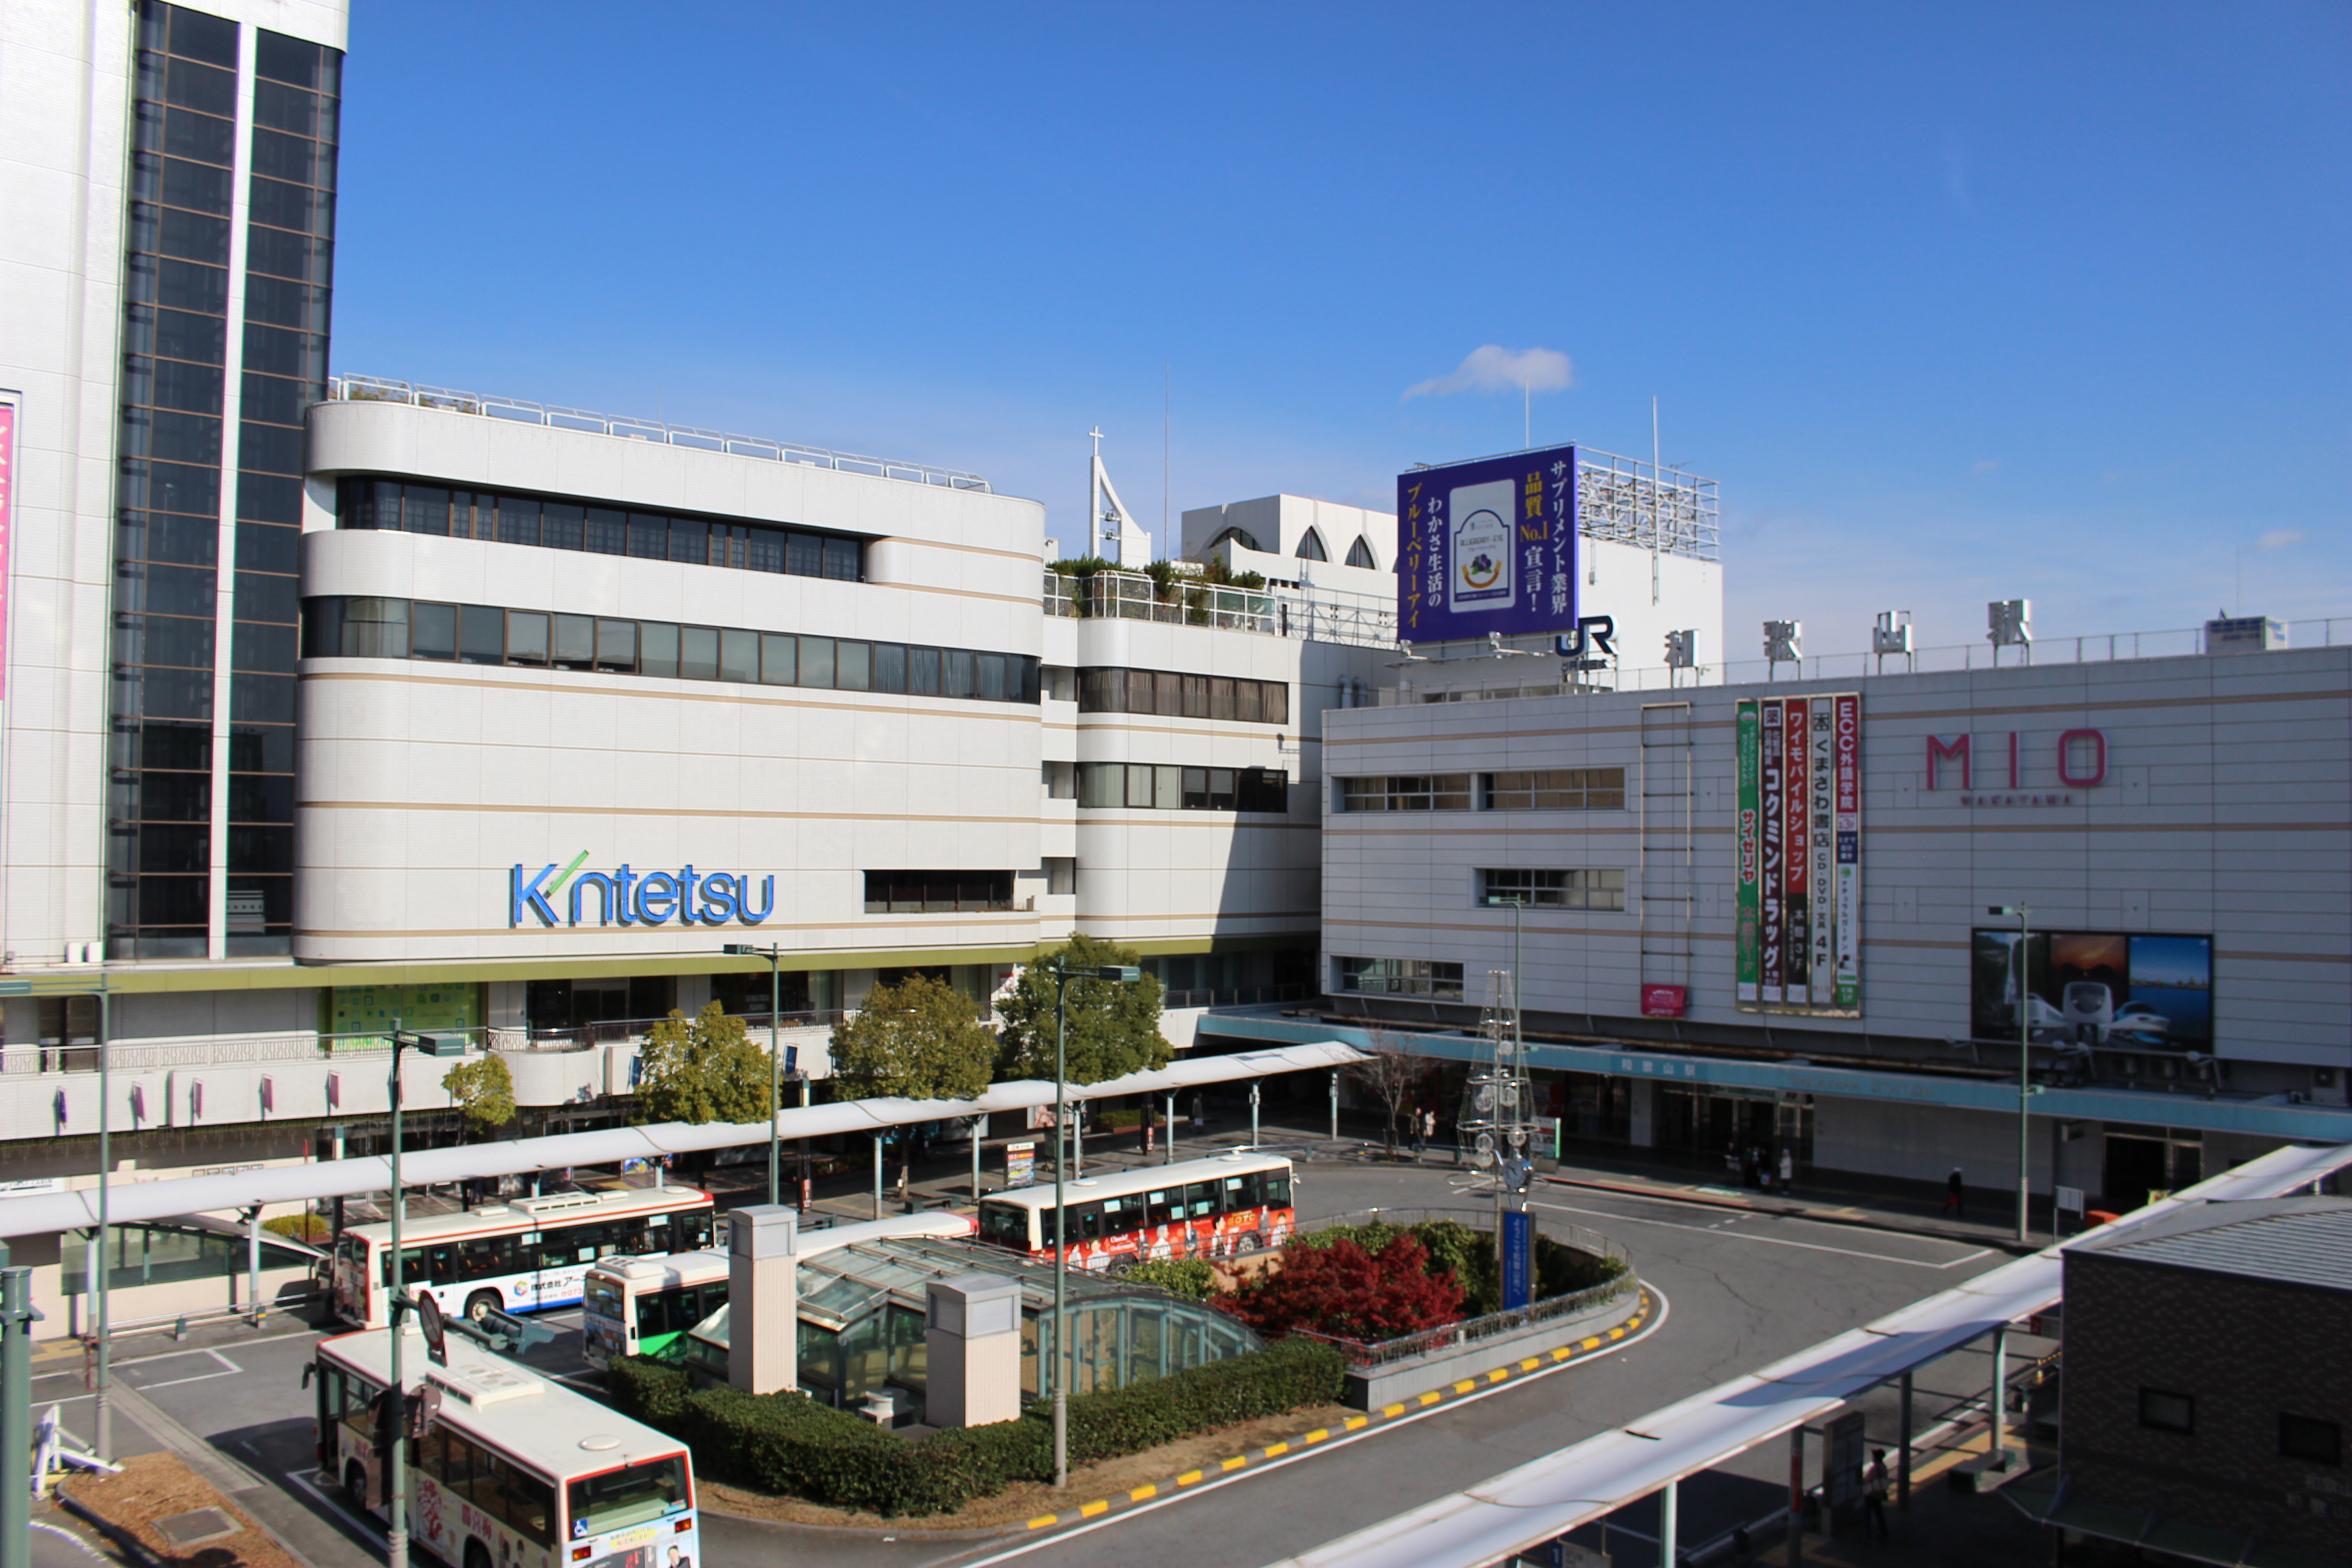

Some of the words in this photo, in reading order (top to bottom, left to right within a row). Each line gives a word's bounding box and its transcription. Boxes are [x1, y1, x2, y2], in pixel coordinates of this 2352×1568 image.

[1406, 482, 1423, 629] ブルーベリーアイ
[1426, 497, 1443, 607] わかさ生活の
[1551, 460, 1568, 616] サプリメント業界
[1555, 615, 1614, 657] JR
[1926, 728, 2106, 789] MIO
[1789, 712, 1805, 882] ワイモバイルショップ
[1959, 794, 2072, 806] WAKAYAMA
[1741, 809, 1757, 885] サイゼリヤ
[1764, 768, 1781, 969] コクミンドラッグ
[514, 849, 774, 923] Kintetsu
[1741, 906, 1756, 974] 本館B1F
[1793, 910, 1806, 970] 本館3F
[1816, 935, 1828, 967] 4F
[1621, 1058, 1696, 1077] 和歌山駅
[1789, 1074, 1861, 1091] WAKAYAMA
[1870, 1080, 1933, 1098] STATION
